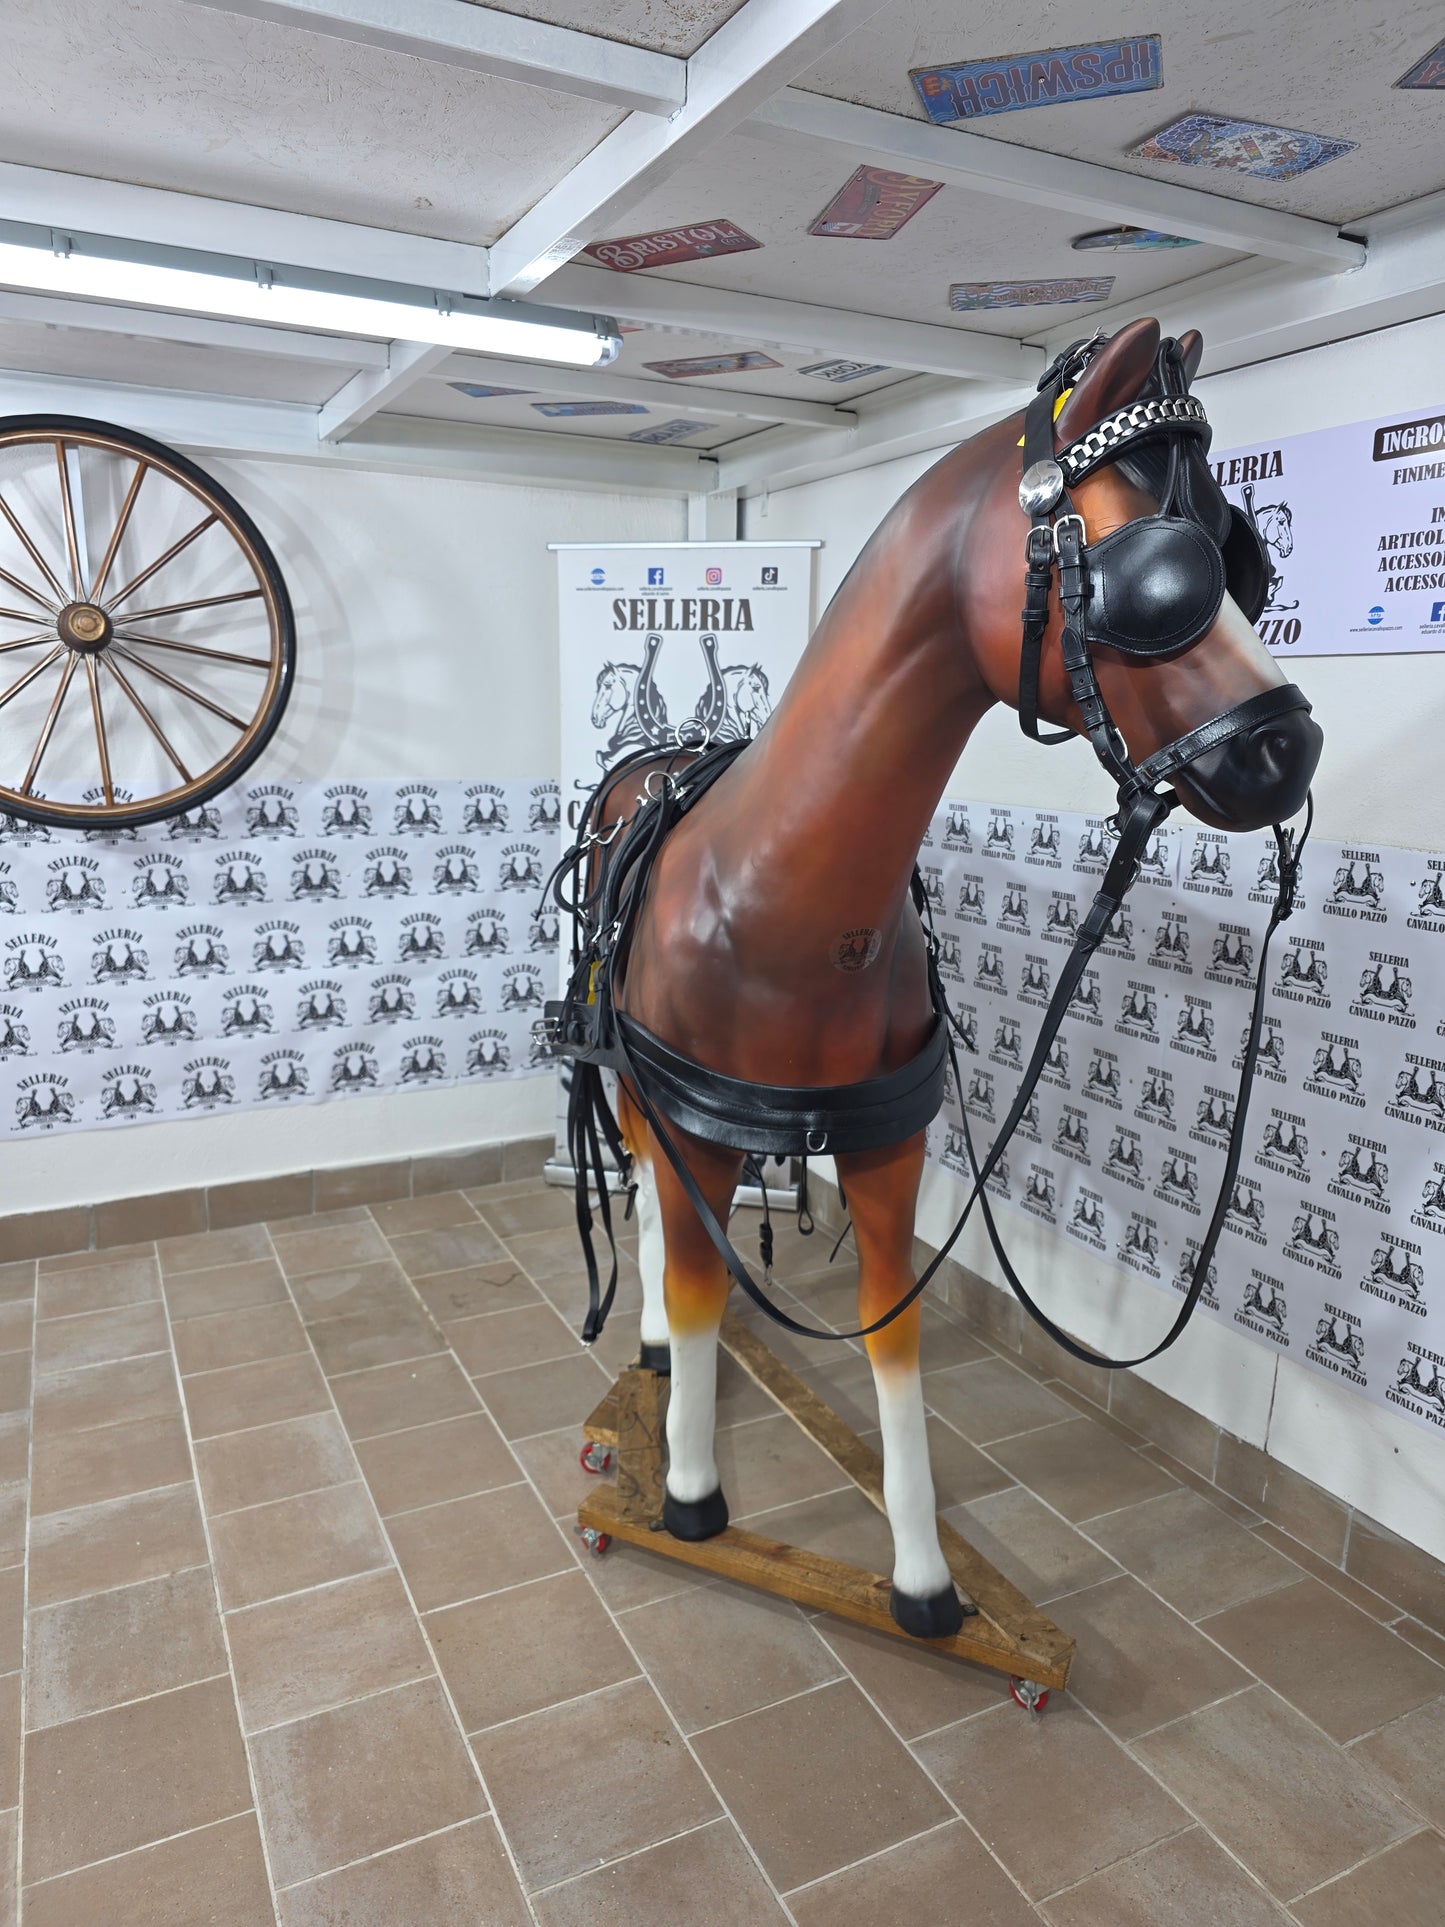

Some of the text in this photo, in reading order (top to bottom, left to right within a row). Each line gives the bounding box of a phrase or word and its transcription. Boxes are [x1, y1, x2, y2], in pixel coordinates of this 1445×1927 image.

[950, 43, 1149, 117] IPSWICH
[596, 225, 744, 268] BRISTOL
[1381, 422, 1445, 454] INGRO
[1208, 450, 1283, 487] LERIA
[613, 598, 754, 631] SELLERIA
[1259, 618, 1302, 645] ZZO
[82, 786, 134, 803] SELLRIA
[248, 785, 294, 801] SELLERIA
[324, 784, 368, 800] SELLERIA
[396, 784, 437, 799] SELLERIA
[464, 784, 505, 799] SELLERIA
[1035, 813, 1058, 823] SELLERIA
[1197, 832, 1227, 844] SELLERIA
[216, 851, 262, 867] SELLERIA
[292, 848, 337, 865] SELLERIA
[365, 847, 409, 862] SELLERIA
[435, 845, 476, 859] SELLERIA
[500, 843, 540, 858] SELLERIA
[1342, 850, 1380, 863] SELLERIA
[48, 855, 99, 873] SELLERIA
[134, 853, 183, 870] SELLERIA
[1024, 854, 1062, 869] CAVALLO PAZZO
[1073, 864, 1095, 874] CAVALLO
[1153, 877, 1172, 887] PAZZO
[1183, 882, 1233, 897] CAVALLO PAZZO
[1052, 891, 1075, 901] SELLERIA
[400, 912, 441, 927] SELLERIA
[467, 909, 506, 923] SELLERIA
[1323, 904, 1387, 923] CAVALLO PAZZO
[255, 920, 300, 935] SELLERIA
[328, 916, 373, 930] SELLERIA
[1219, 922, 1250, 936] SELLERIA
[93, 928, 143, 945] SELLERIA
[176, 924, 223, 940] SELLERIA
[1041, 932, 1062, 943] CAVALLO
[4, 933, 58, 951] SELLERIA
[1289, 936, 1325, 951] SELLERIA
[1025, 953, 1048, 965] SELLERIA
[1118, 950, 1135, 961] PAZZO
[1369, 951, 1409, 968] SELLERIA
[438, 968, 478, 982] SELLERIA
[502, 964, 541, 977] SELLERIA
[1174, 963, 1193, 975] PAZZO
[298, 980, 343, 995] SELLERIA
[371, 974, 412, 989] SELLERIA
[1127, 980, 1155, 994] SELLERIA
[1204, 971, 1257, 991] CAVALLO PAZZO
[143, 991, 191, 1007] SELLERIA
[222, 984, 269, 1000] SELLERIA
[1017, 994, 1036, 1006] CAVALLO
[1272, 987, 1331, 1009] CAVALLO PAZZO
[58, 998, 109, 1016] SELLERIA
[1184, 994, 1212, 1009] SELLERIA
[1085, 1014, 1103, 1026] PAZZO
[1349, 1006, 1416, 1029] CAVALLO PAZZO
[468, 1029, 508, 1043] SELLERIA
[1115, 1024, 1159, 1044] CAVALLO PAZZO
[1321, 1031, 1359, 1049] SELLERIA
[333, 1042, 375, 1058] SELLERIA
[403, 1036, 443, 1050] SELLERIA
[1170, 1040, 1217, 1062] CAVALLO PAZZO
[260, 1049, 305, 1066] SELLERIA
[1093, 1048, 1118, 1062] SELLERIA
[102, 1064, 152, 1082] SELLERIA
[183, 1057, 231, 1073] SELLERIA
[16, 1072, 69, 1091] SELLERIA
[1264, 1068, 1287, 1083] PAZZO
[1081, 1089, 1122, 1110] CAVALLO PAZZO
[1204, 1085, 1235, 1102] SELLERIA
[1303, 1081, 1365, 1108] CAVALLO PAZZO
[1063, 1104, 1087, 1119] SELLERIA
[1271, 1108, 1305, 1126] SELLERIA
[1385, 1107, 1422, 1125] CAVALLO
[1115, 1125, 1140, 1142] SELLERIA
[1158, 1119, 1176, 1131] PAZZO
[1189, 1130, 1216, 1147] CAVALLO
[1348, 1133, 1387, 1154] SELLERIA
[1052, 1143, 1091, 1166] CAVALLO PAZZO
[1168, 1147, 1197, 1164] SELLERIA
[1102, 1166, 1145, 1191] CAVALLO PAZZO
[1255, 1156, 1311, 1184] CAVALLO PAZZO
[1079, 1186, 1103, 1204] SELLERIA
[1153, 1189, 1200, 1216] CAVALLO PAZZO
[1327, 1183, 1391, 1215] CAVALLO PAZZO
[1300, 1200, 1336, 1222] SELLERIA
[1066, 1225, 1106, 1251] CAVALLO PAZZO
[1245, 1231, 1267, 1247] PAZZO
[1381, 1232, 1422, 1255] SELLERIA
[1141, 1265, 1160, 1279] PAZZO
[1282, 1247, 1342, 1280] CAVALLO PAZZO
[1251, 1269, 1284, 1291] SELLERIA
[1200, 1296, 1219, 1311] PAZZO
[1360, 1281, 1427, 1318] CAVALLO PAZZO
[1324, 1303, 1362, 1328] SELLERIA
[1234, 1313, 1289, 1346] CAVALLO PAZZO
[1305, 1350, 1367, 1387] CAVALLO PAZZO
[1385, 1390, 1423, 1413] CAVALLO
